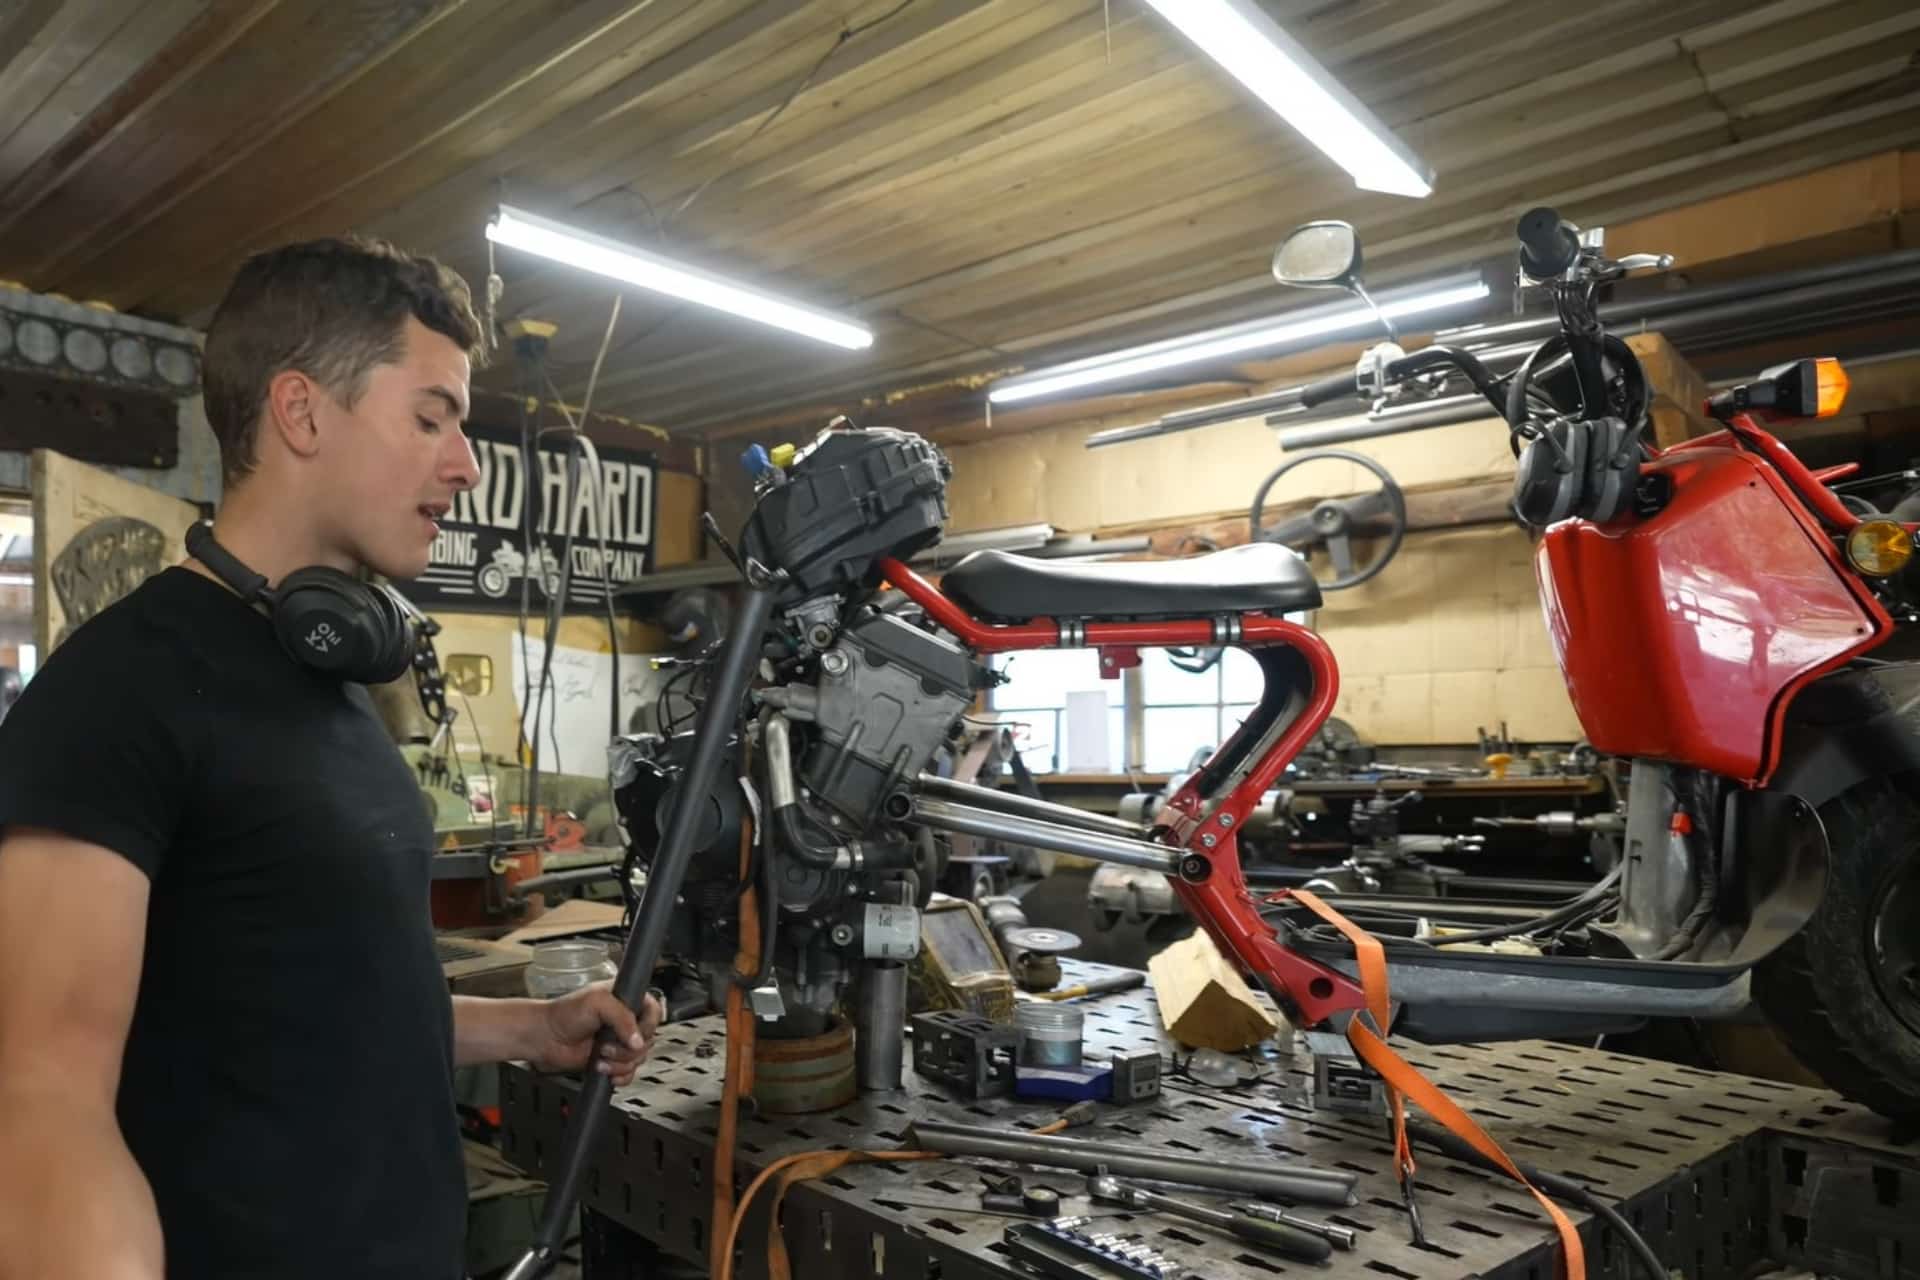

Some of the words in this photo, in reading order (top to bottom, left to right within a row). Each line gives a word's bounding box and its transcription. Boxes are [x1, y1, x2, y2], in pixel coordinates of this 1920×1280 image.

[442, 439, 523, 530] ND
[536, 450, 652, 545] HARD
[428, 530, 478, 566] BING
[571, 545, 645, 580] COMPANY
